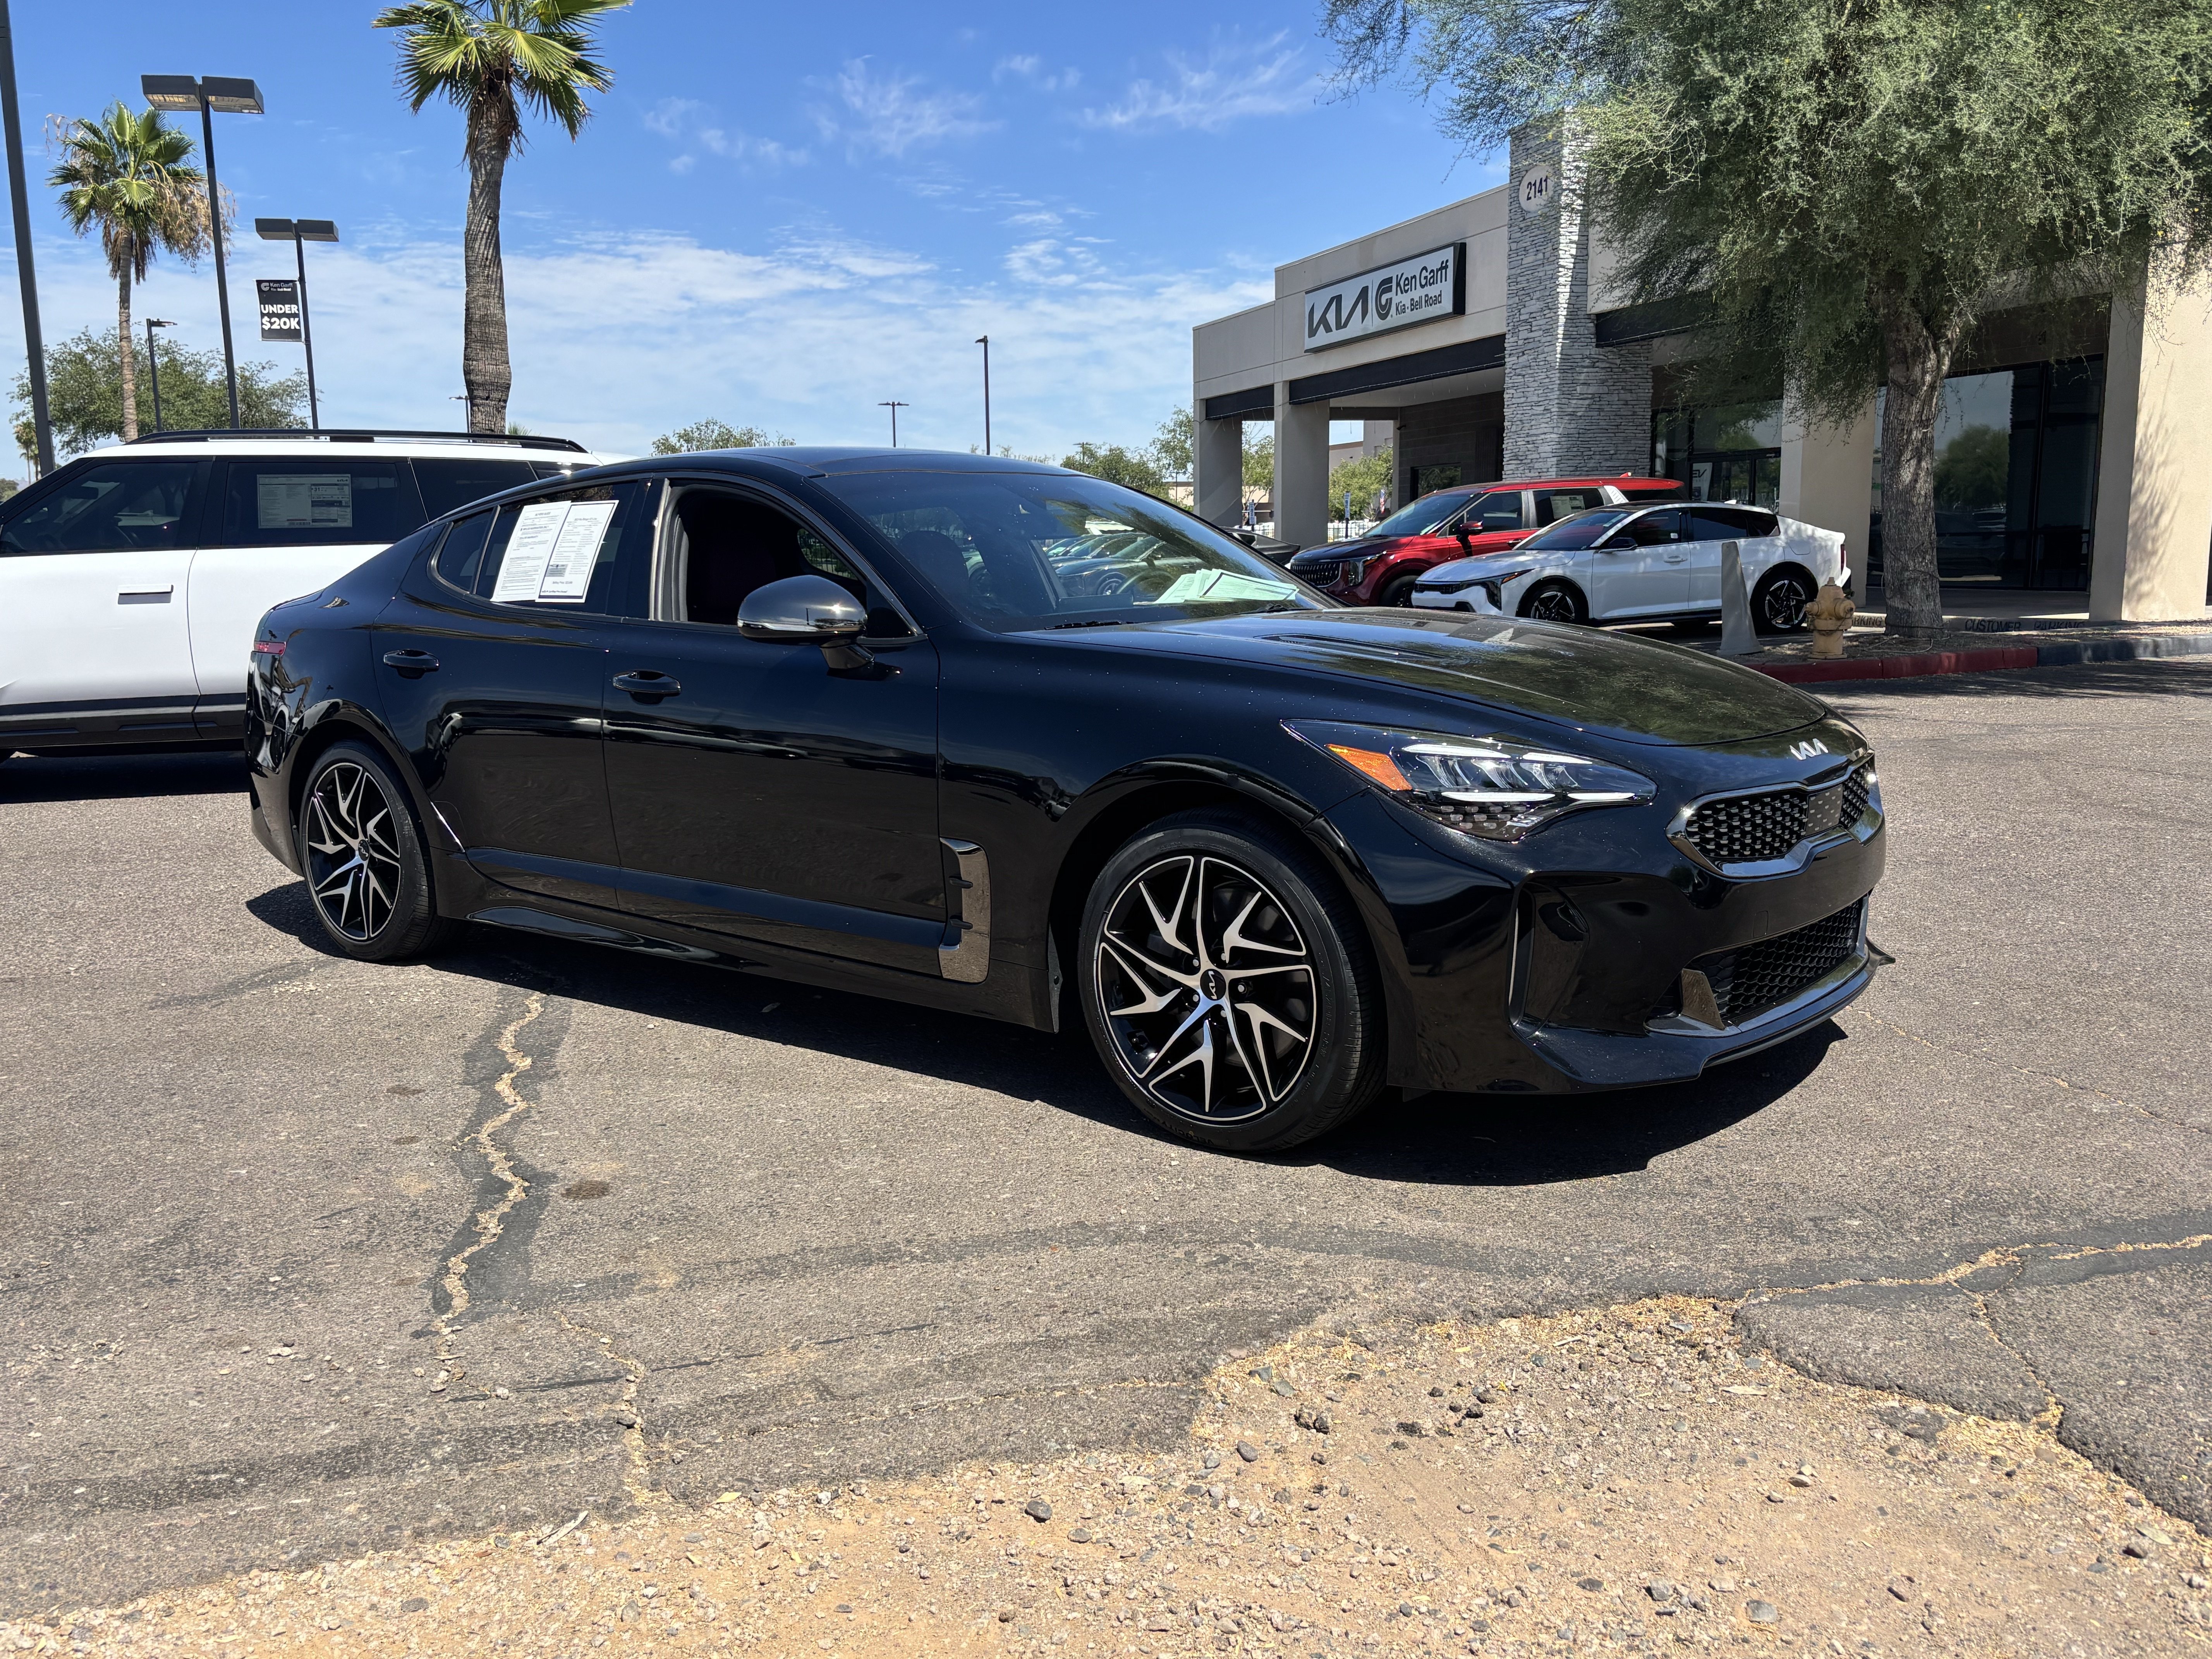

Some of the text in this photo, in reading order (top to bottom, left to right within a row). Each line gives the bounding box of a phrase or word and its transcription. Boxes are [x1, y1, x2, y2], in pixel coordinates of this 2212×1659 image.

[1527, 175, 1548, 201] 2141
[1395, 259, 1449, 296] Ken Garff
[261, 304, 299, 314] UNDER
[1308, 285, 1369, 338] KIA
[1396, 290, 1442, 316] Kia Bell Road
[262, 316, 300, 330] $20K
[1965, 619, 2021, 632] CUSTOMER
[1790, 738, 1829, 760] KIA
